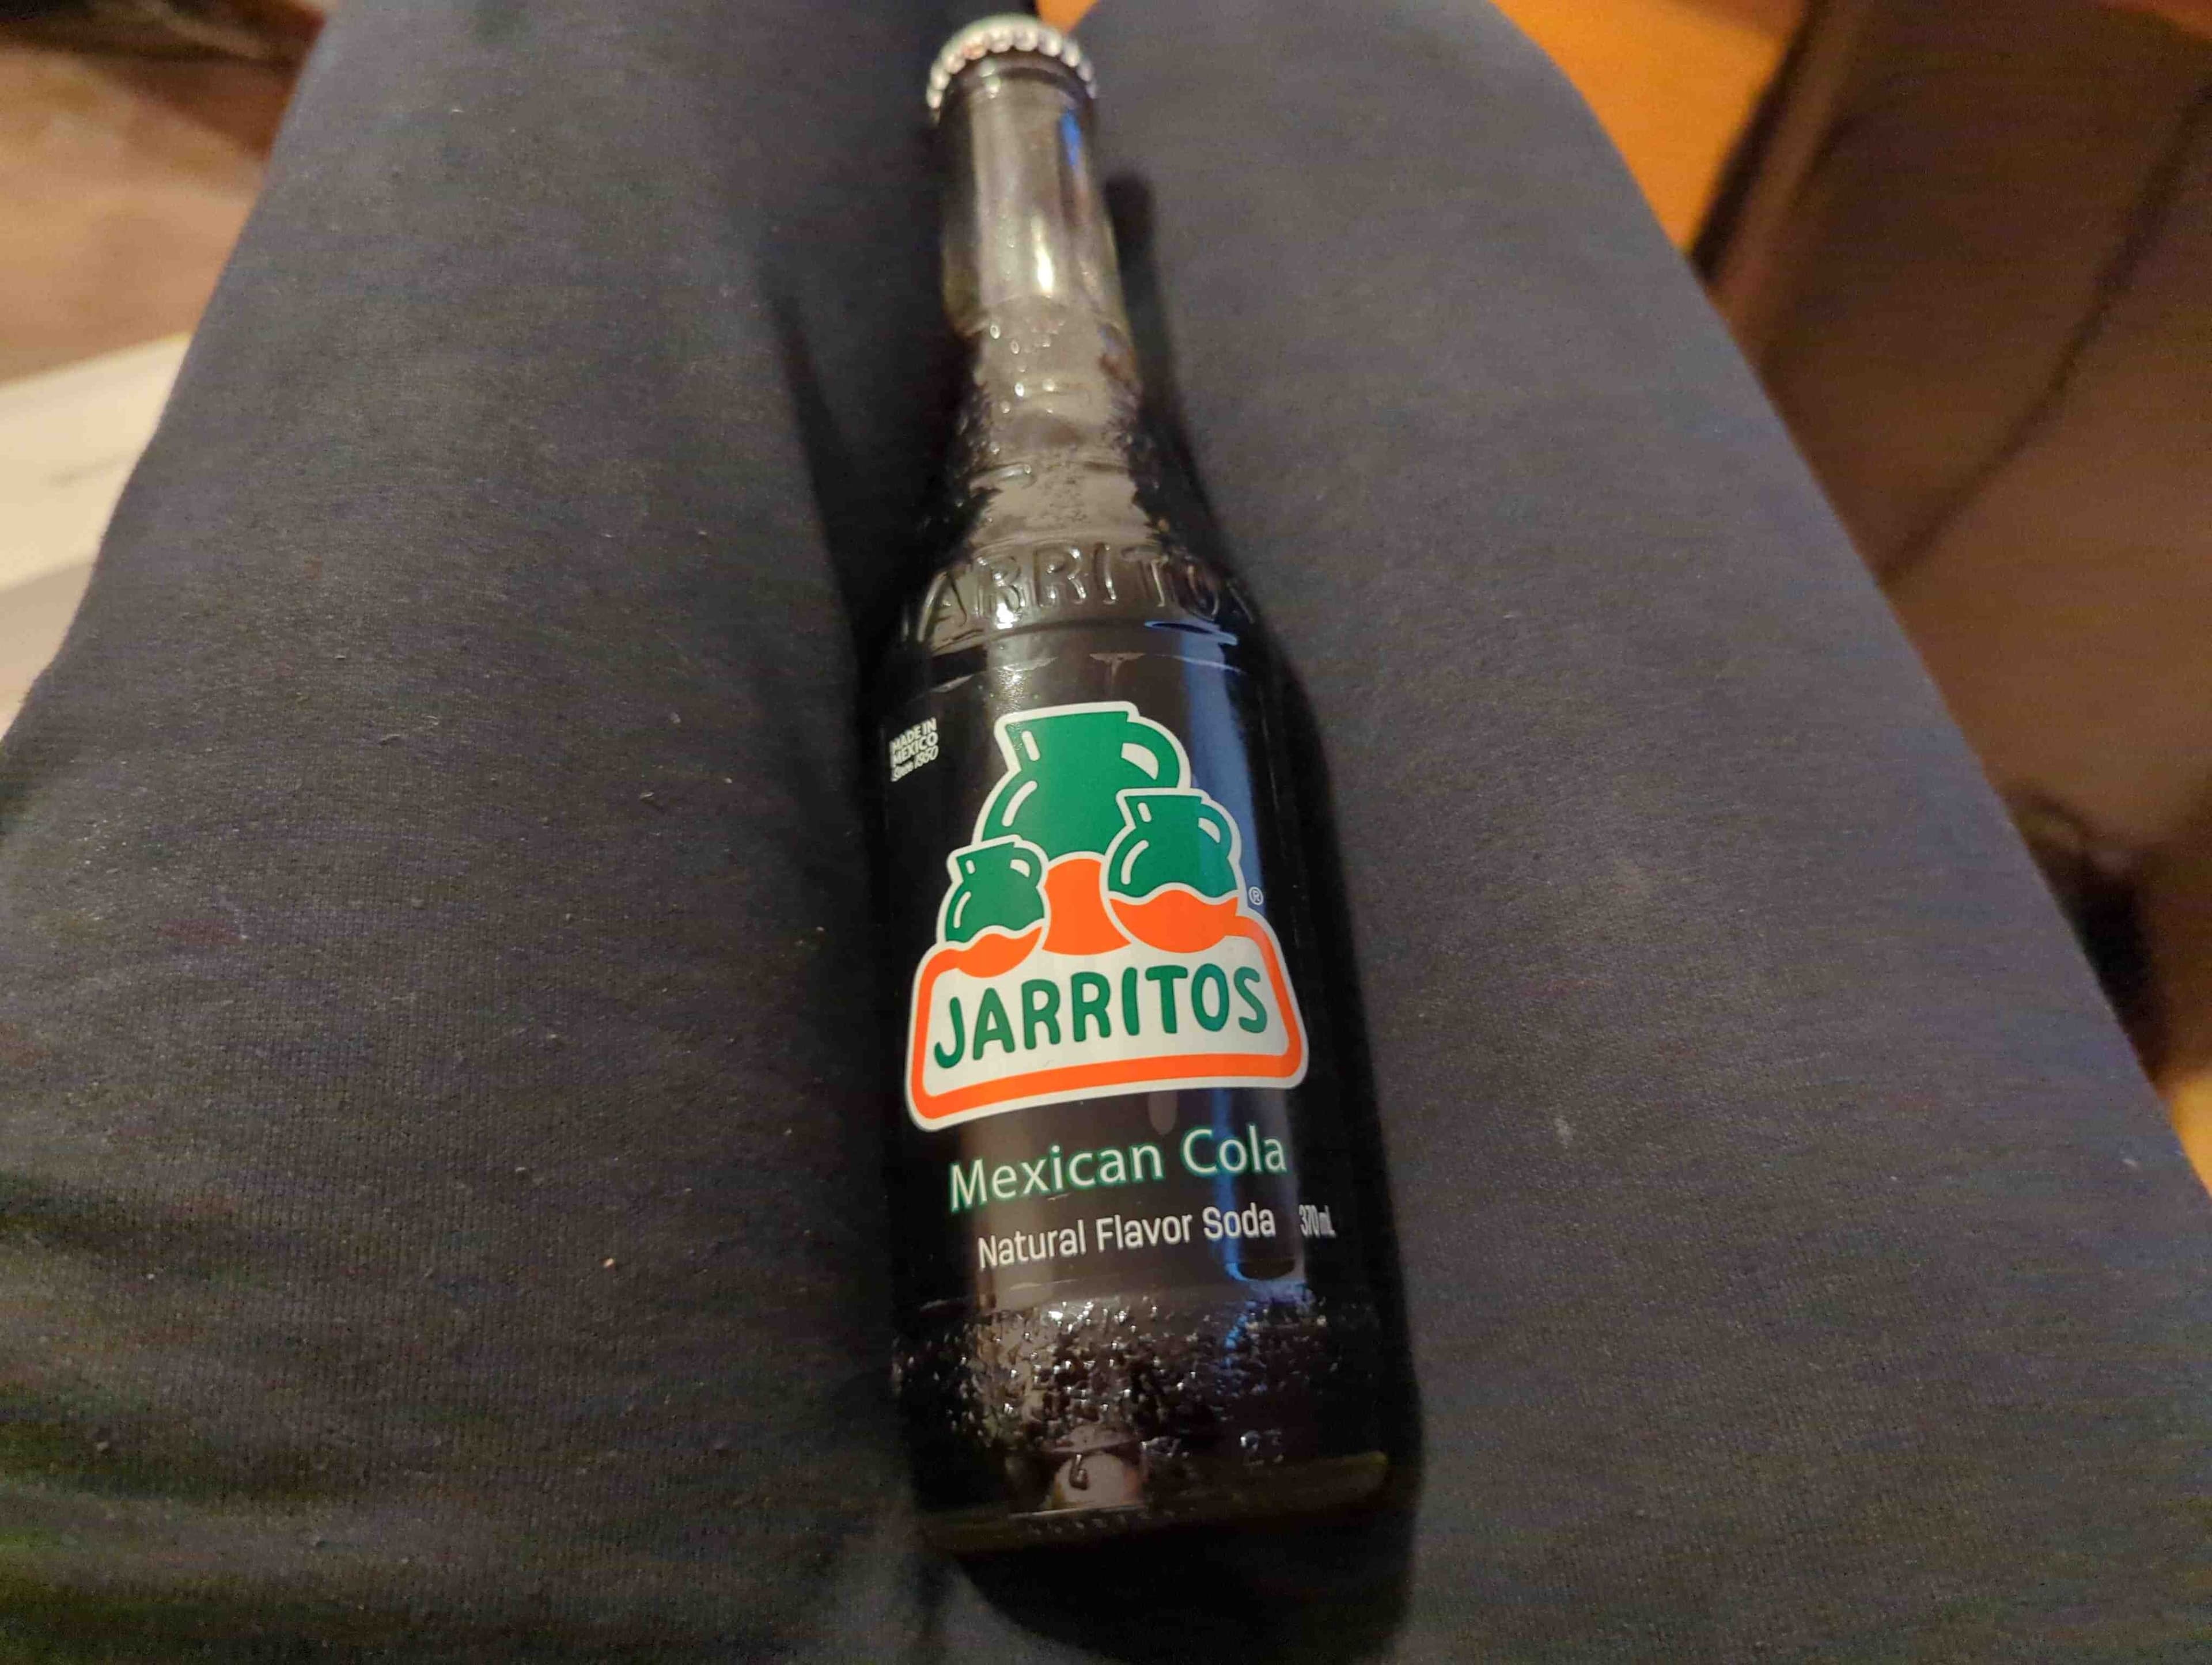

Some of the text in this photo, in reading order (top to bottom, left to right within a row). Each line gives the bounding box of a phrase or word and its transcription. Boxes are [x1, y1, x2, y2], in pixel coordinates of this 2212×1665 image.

[889, 716, 937, 752] MADE IN
[890, 731, 938, 769] MEXICO
[934, 963, 1268, 1068] JARRITOS
[949, 1123, 1287, 1213] Mexican Cola
[978, 1202, 1277, 1270] Natural Flavor Soda
